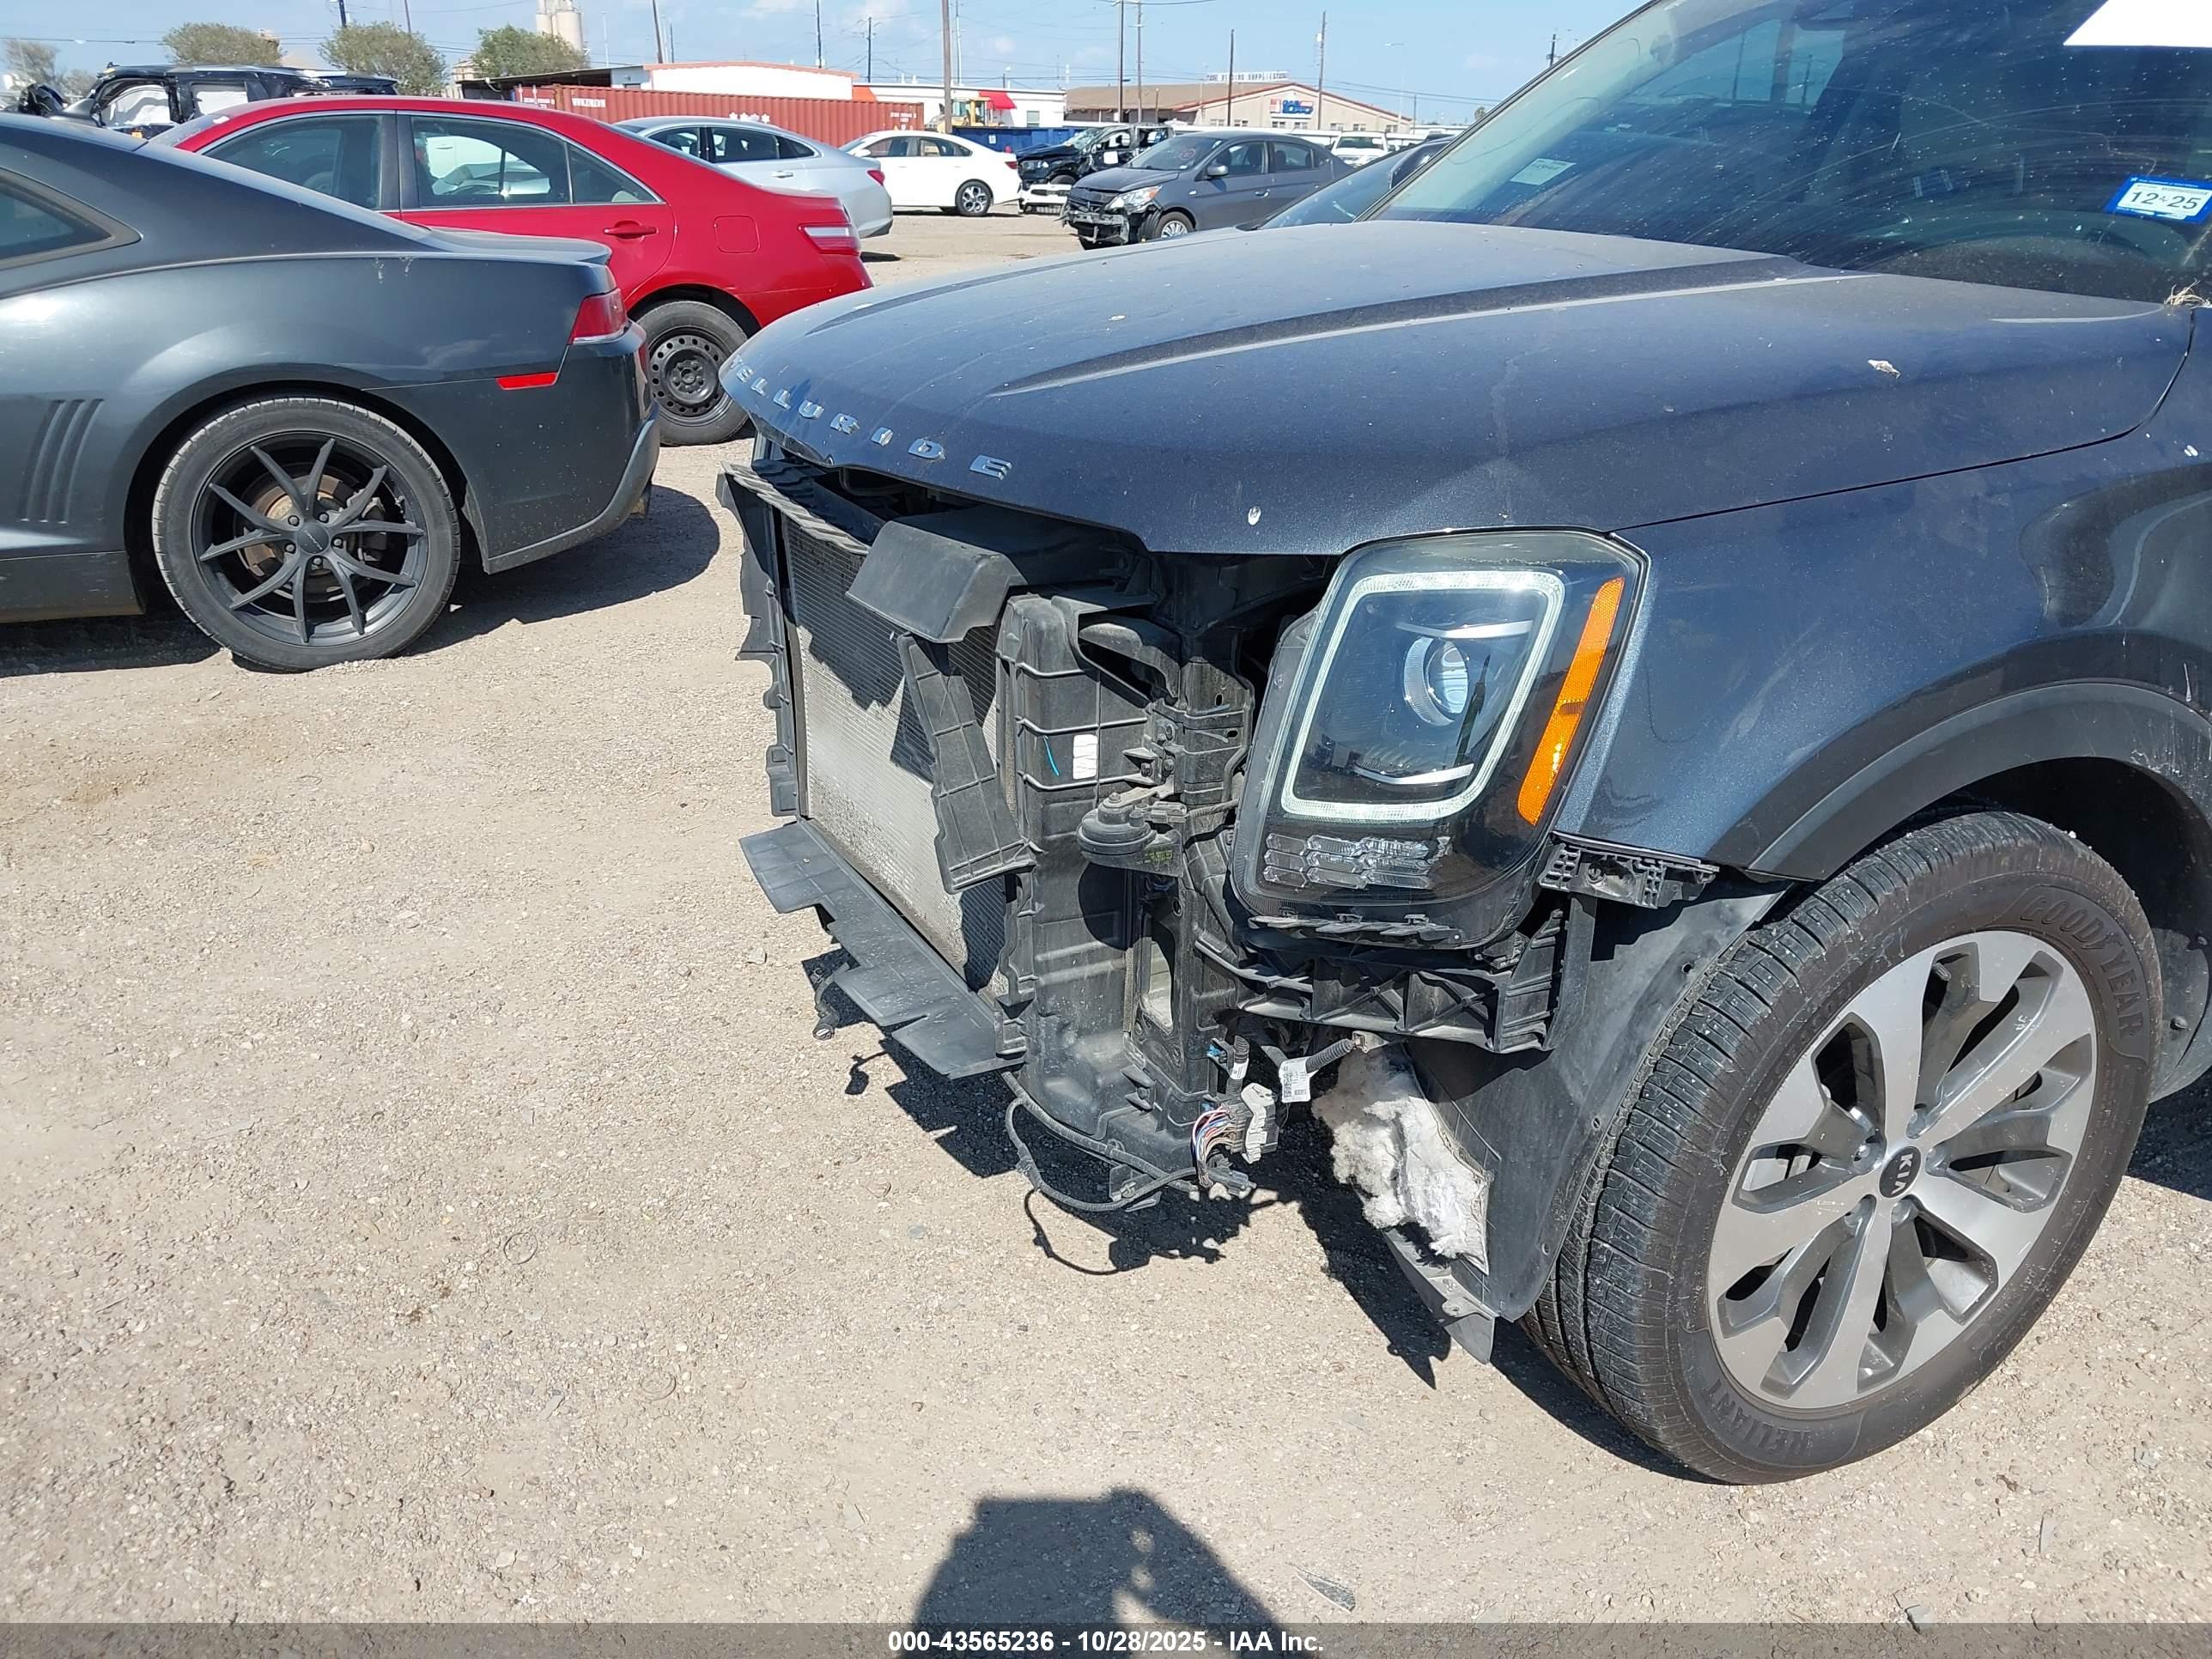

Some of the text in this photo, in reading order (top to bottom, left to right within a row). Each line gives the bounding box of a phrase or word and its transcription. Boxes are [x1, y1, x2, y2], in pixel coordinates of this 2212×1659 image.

[2130, 191, 2160, 205] 12
[2166, 196, 2202, 210] 25
[730, 355, 1012, 481] TELLURIDE
[1891, 1153, 1913, 1195] KIA
